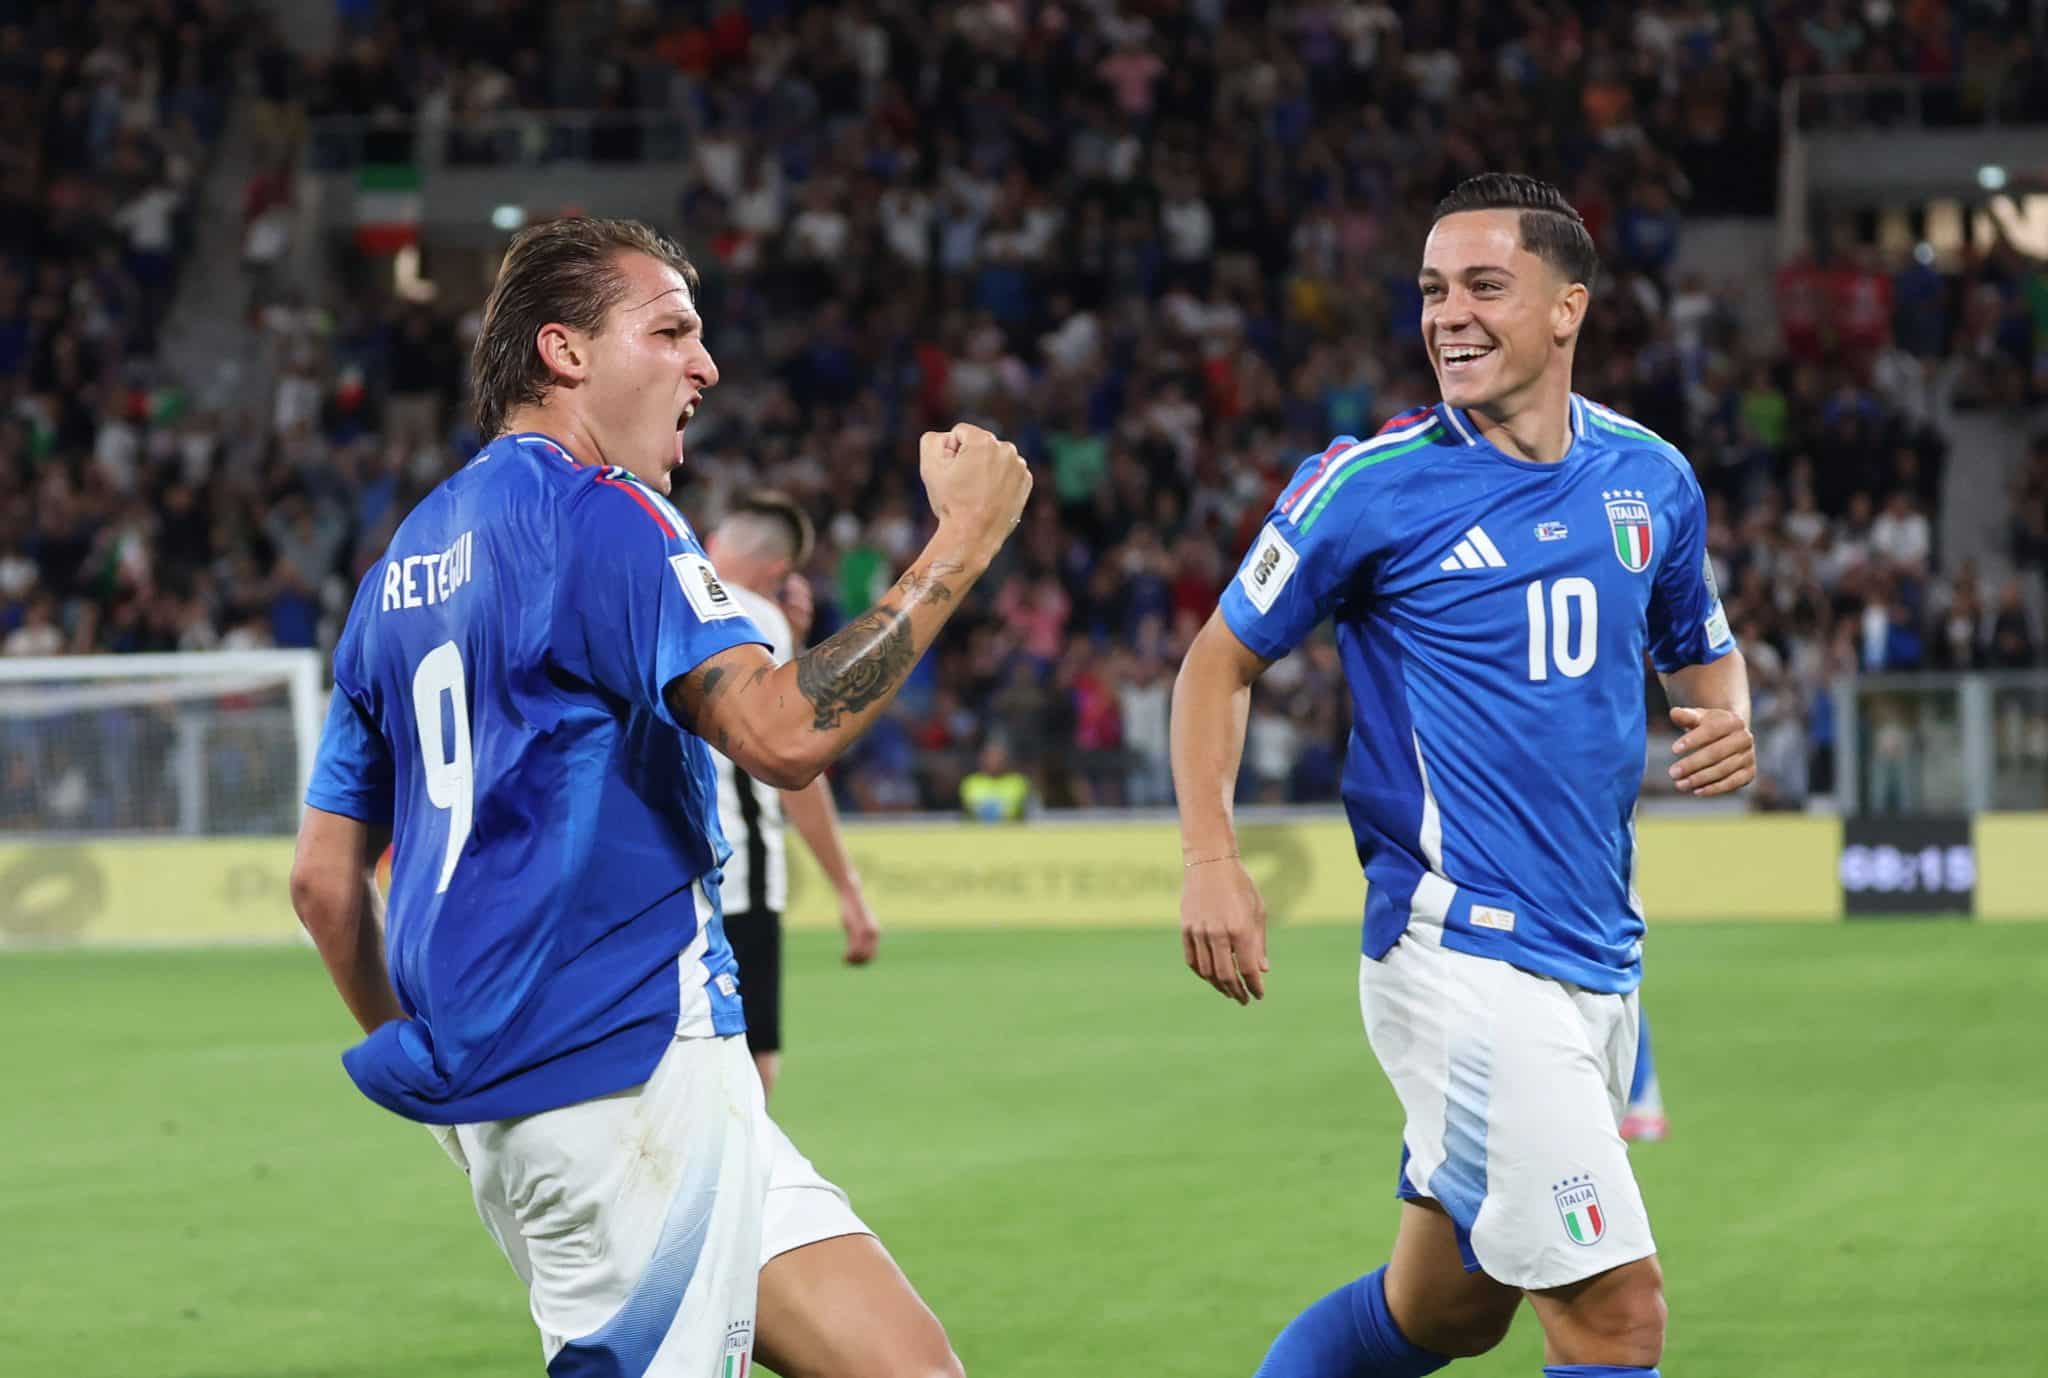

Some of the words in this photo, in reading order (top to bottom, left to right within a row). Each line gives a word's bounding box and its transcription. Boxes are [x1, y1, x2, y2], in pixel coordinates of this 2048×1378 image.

[1610, 506, 1647, 520] ITALIA
[382, 530, 473, 612] RETEGUI
[1526, 577, 1598, 680] 10
[412, 640, 475, 894] 9
[1559, 1188, 1593, 1208] ITALIA
